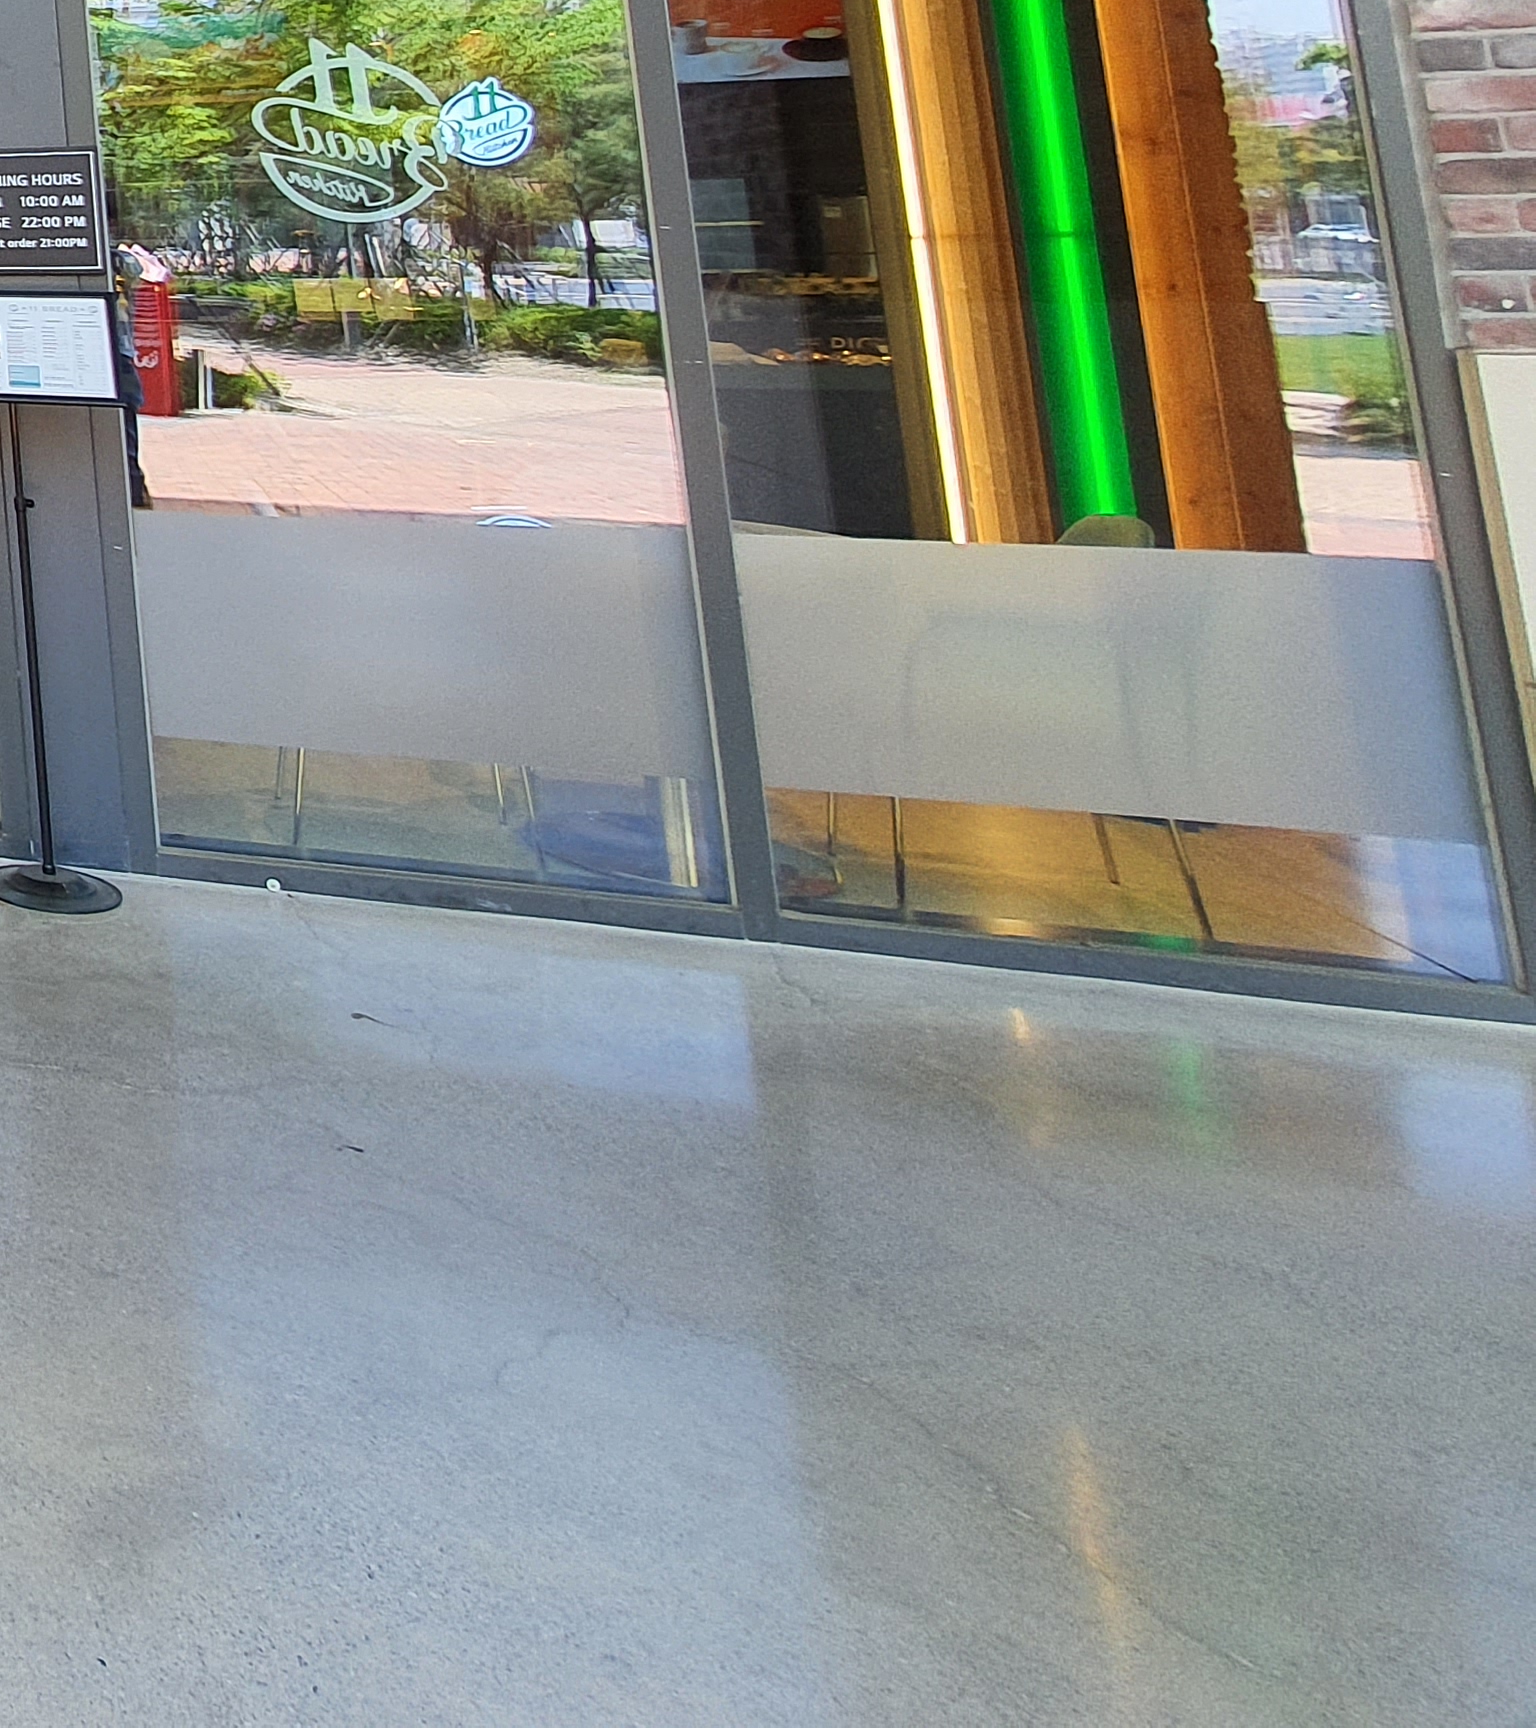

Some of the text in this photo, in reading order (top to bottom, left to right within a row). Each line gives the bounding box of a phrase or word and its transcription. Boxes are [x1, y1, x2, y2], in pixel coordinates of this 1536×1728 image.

[440, 104, 528, 152] Bread
[31, 173, 84, 187] HOURS
[19, 195, 59, 208] 10:00
[61, 194, 85, 207] AM
[21, 216, 62, 228] 22:00
[64, 215, 87, 228] PM
[7, 237, 38, 249] order
[39, 237, 89, 249] 21:00PM
